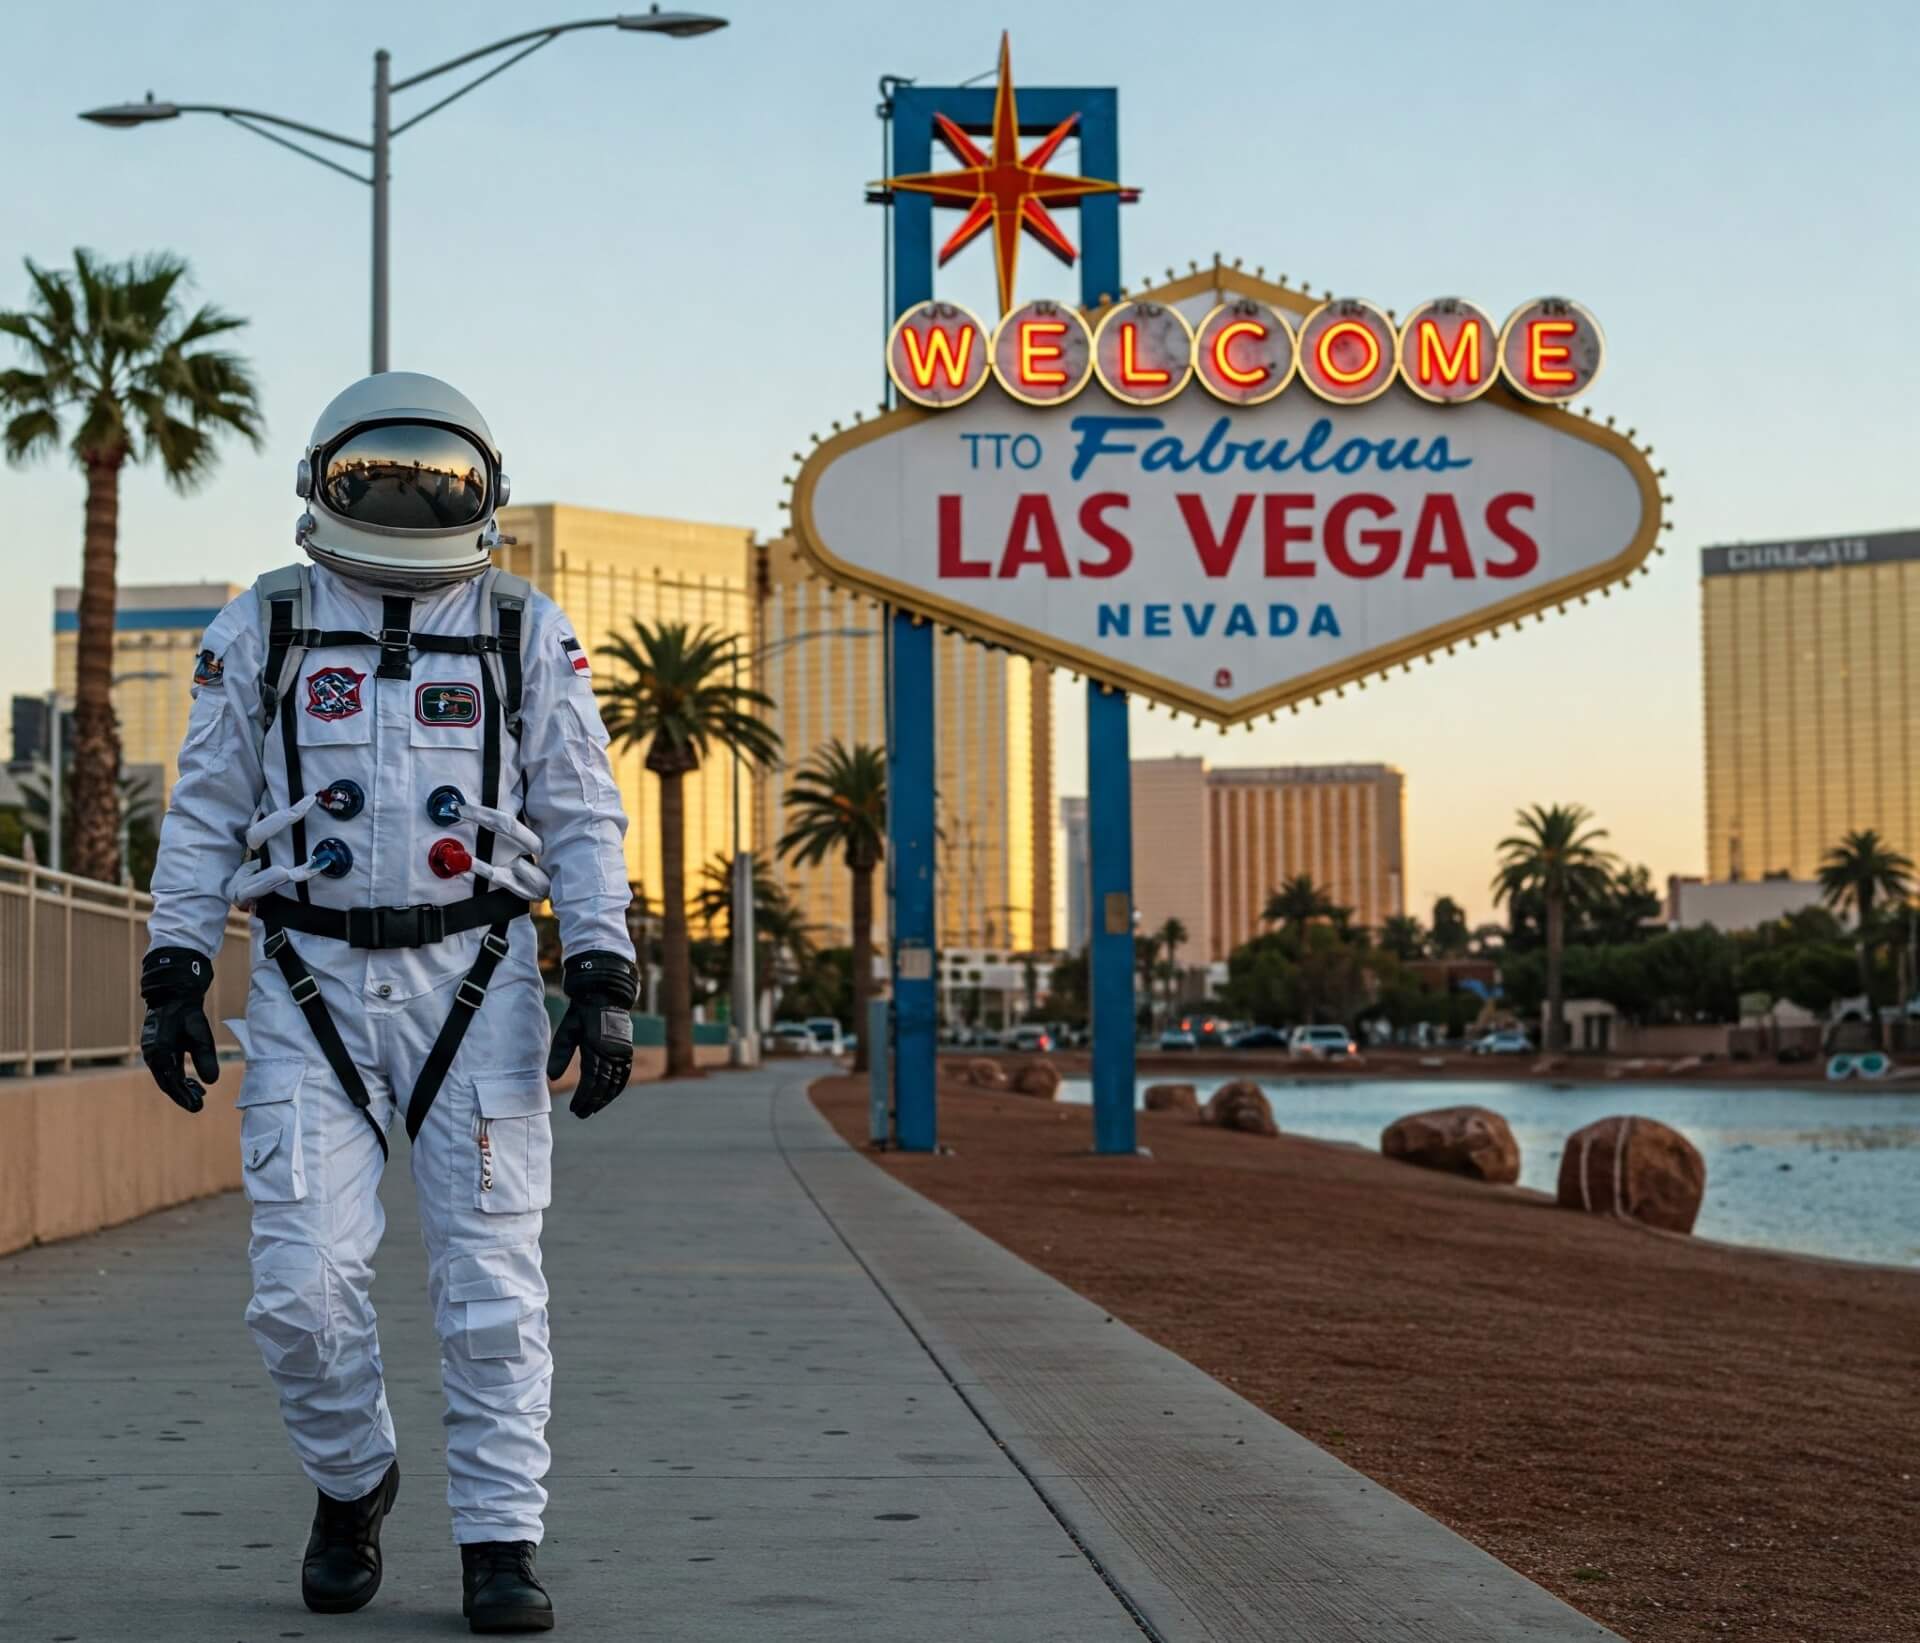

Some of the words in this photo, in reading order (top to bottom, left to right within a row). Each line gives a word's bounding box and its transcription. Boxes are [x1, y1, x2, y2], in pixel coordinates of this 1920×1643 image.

[901, 320, 1577, 389] WELCOME
[1070, 415, 1473, 482] Fabulous
[938, 493, 1132, 579] LAS
[1178, 493, 1539, 579] VEGAS
[1097, 602, 1342, 639] NEVADA
